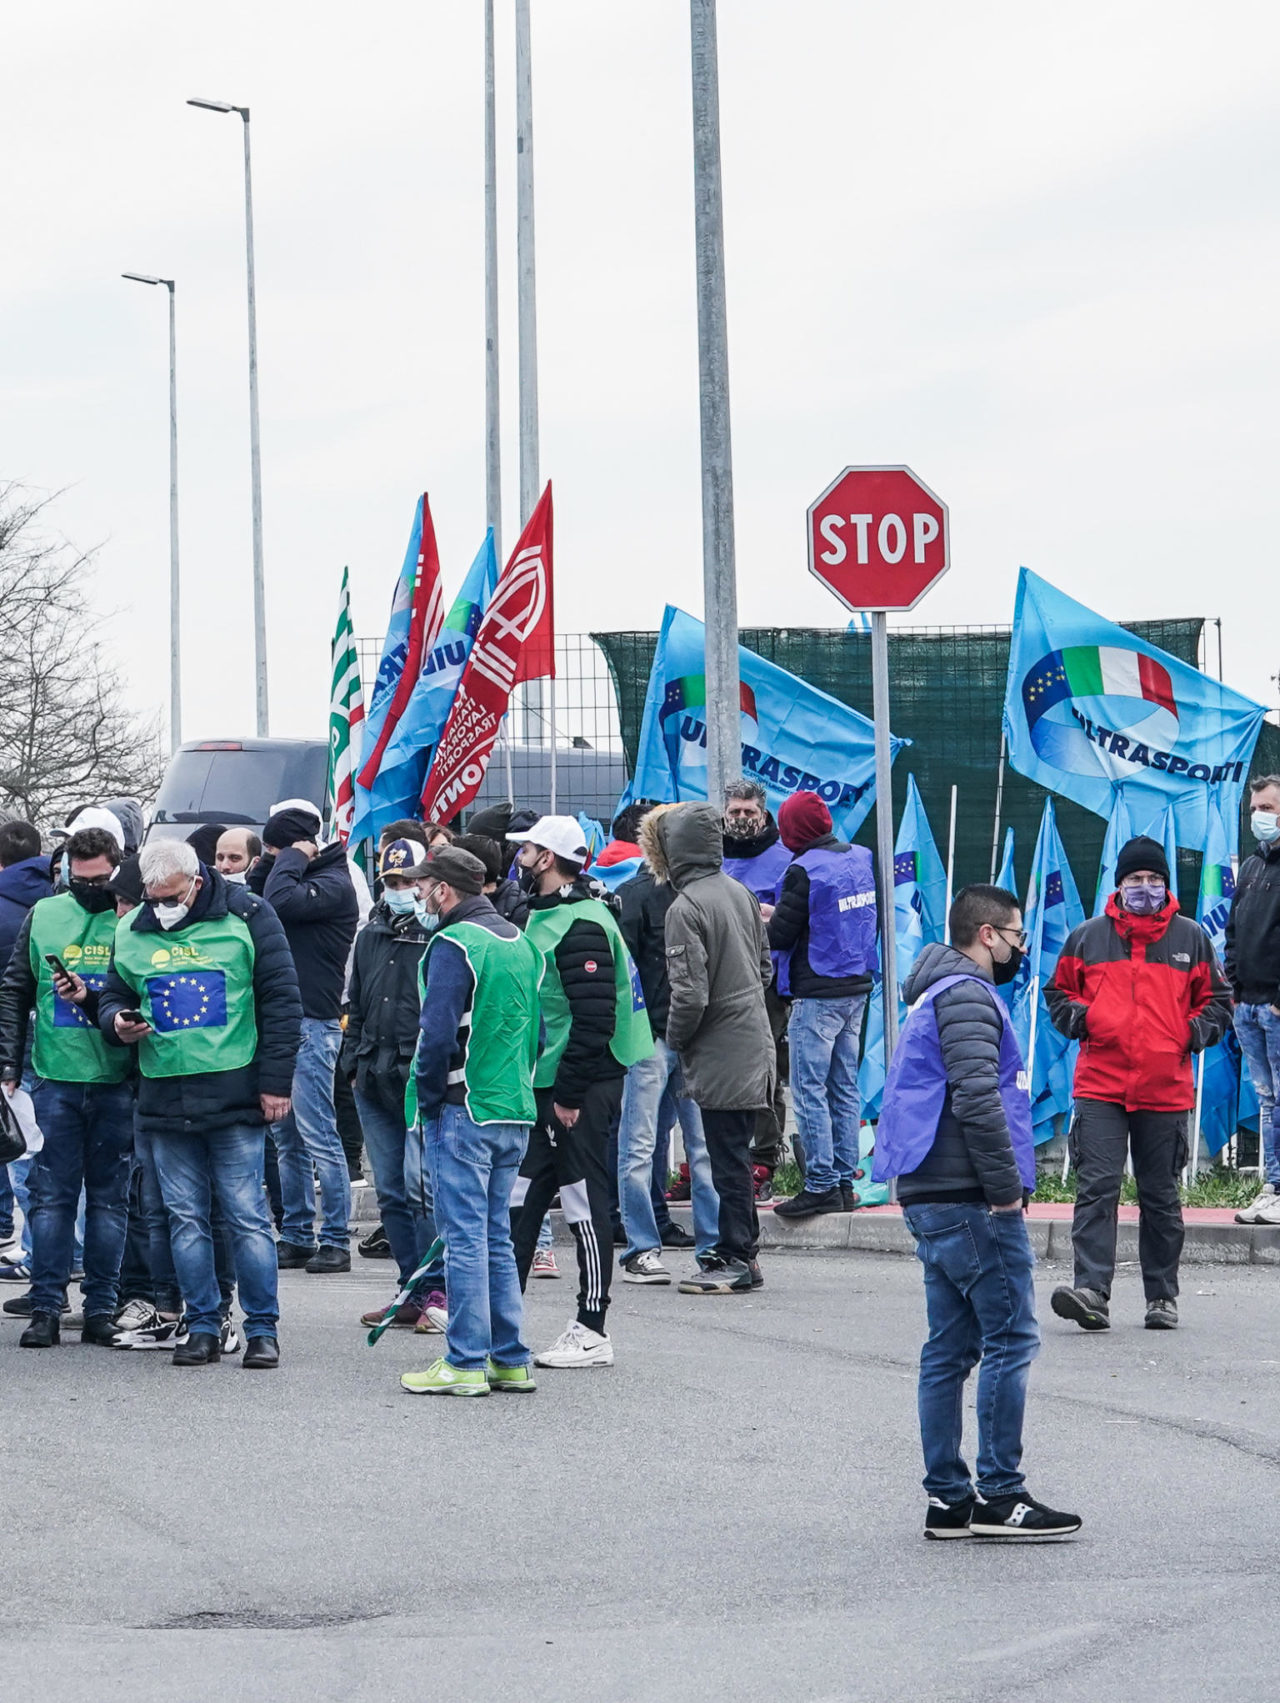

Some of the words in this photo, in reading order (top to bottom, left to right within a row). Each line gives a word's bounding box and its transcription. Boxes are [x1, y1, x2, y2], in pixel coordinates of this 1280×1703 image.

[820, 513, 939, 565] STOP
[84, 945, 111, 956] CISL
[171, 946, 199, 956] CISL
